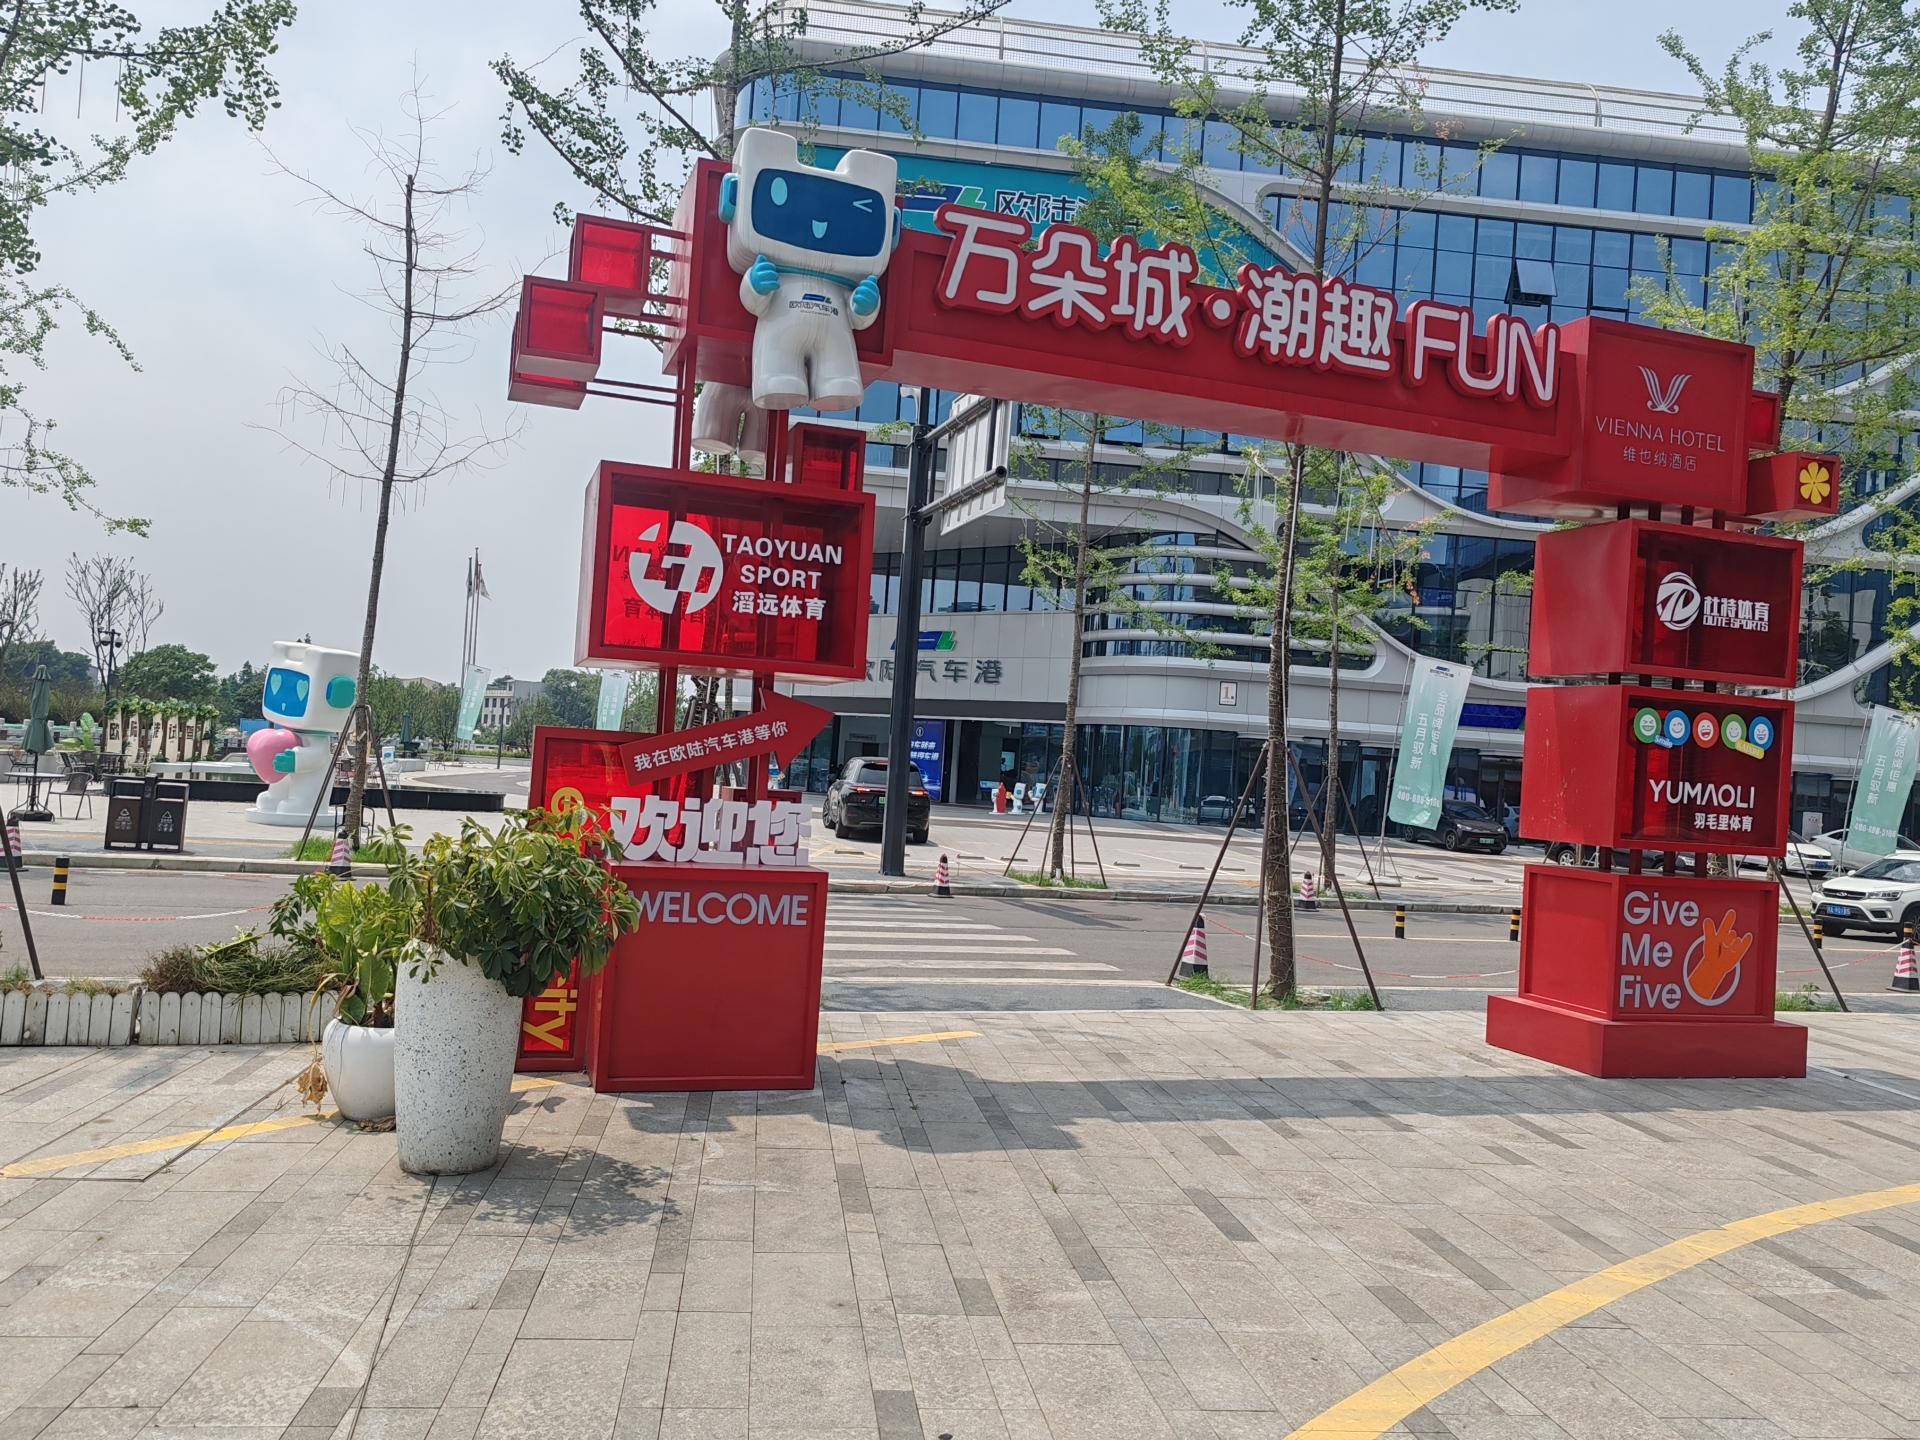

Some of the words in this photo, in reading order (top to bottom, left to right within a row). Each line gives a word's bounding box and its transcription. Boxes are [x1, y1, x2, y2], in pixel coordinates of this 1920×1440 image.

[1412, 305, 1557, 402] FUN
[1595, 415, 1664, 442] VIENNA
[1670, 428, 1726, 452] HOTEL
[1623, 446, 1697, 471] 维也纳酒店
[722, 533, 843, 565] TAOYUAN
[740, 564, 822, 589] SPORT
[732, 590, 827, 621] 滔远体育
[1703, 596, 1770, 621] 杜特体育
[1731, 618, 1769, 632] SPORTS
[634, 721, 788, 771] 我在欧陆汽车港等你
[1649, 779, 1755, 809] YUMAOLI
[608, 795, 813, 866] 欢迎您
[1693, 812, 1753, 832] 羽毛里体育
[628, 890, 809, 926] WELCOME
[1623, 890, 1700, 927] Give
[1621, 932, 1673, 968] Me
[1619, 974, 1682, 1010] Five
